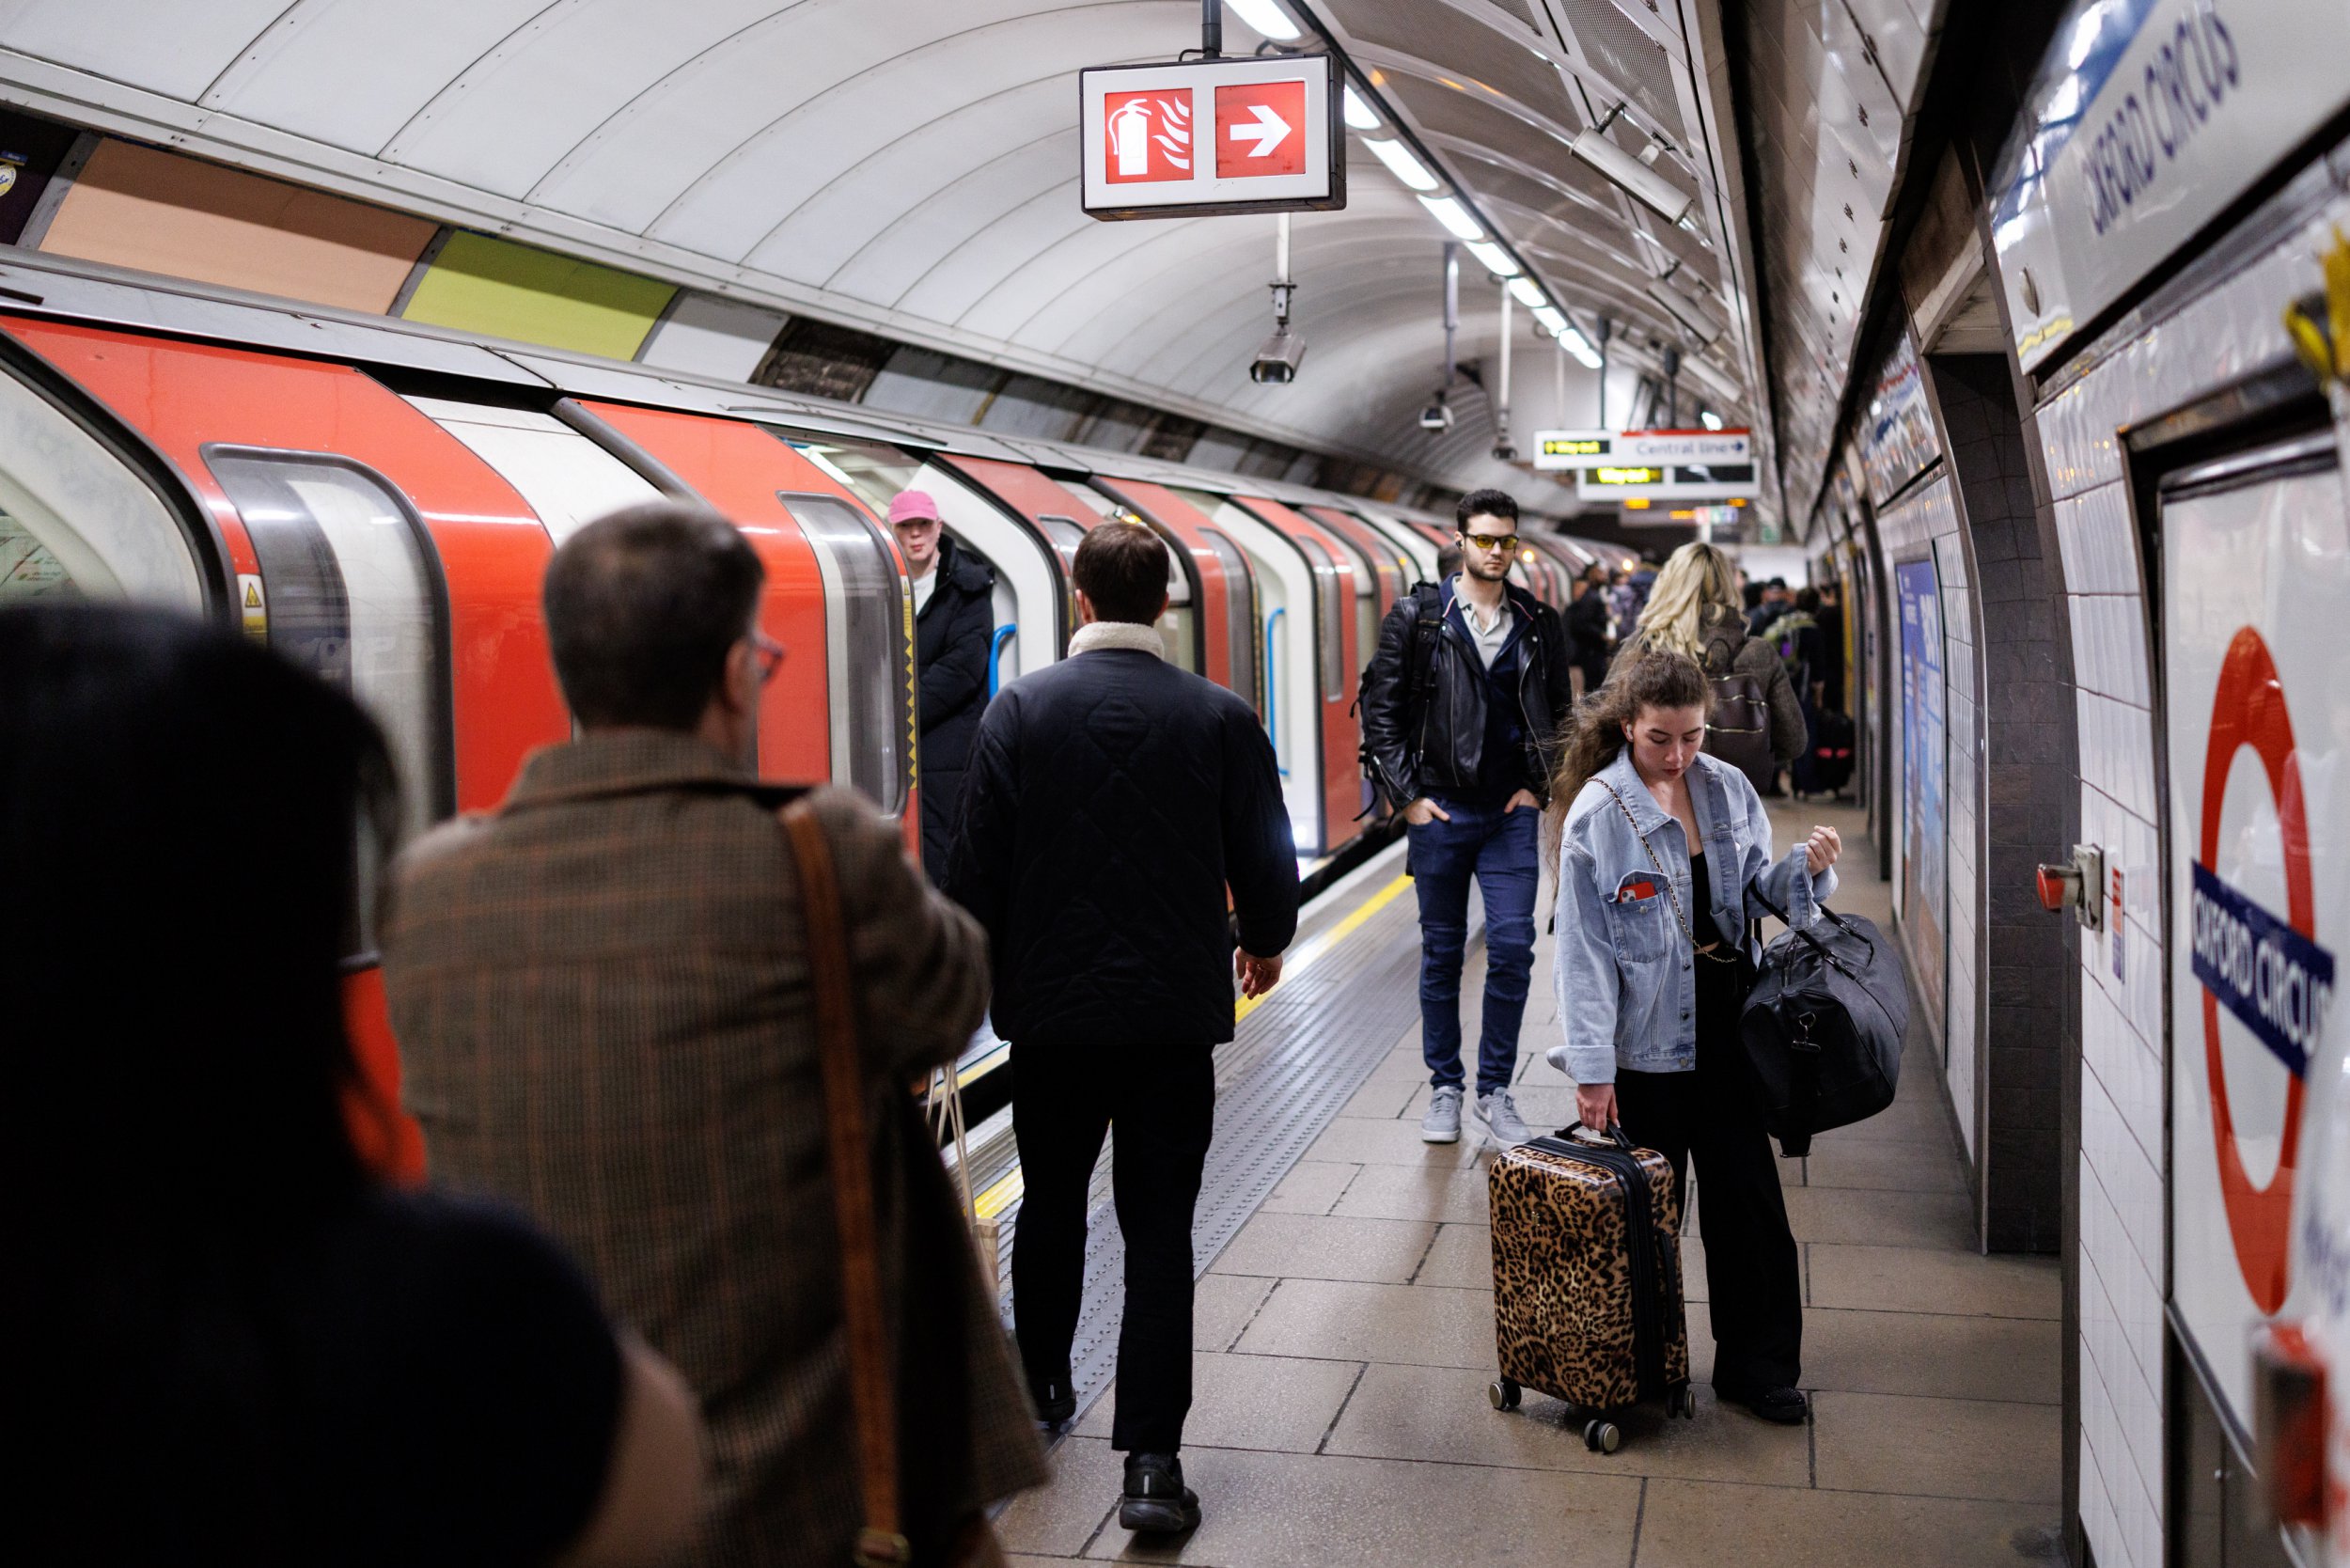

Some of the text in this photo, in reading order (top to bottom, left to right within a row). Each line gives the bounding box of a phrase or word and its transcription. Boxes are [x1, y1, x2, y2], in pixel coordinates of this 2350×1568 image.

[2081, 4, 2240, 236] OXFORD CIRCUS
[1636, 440, 1729, 455] Central line
[2191, 887, 2253, 996] OXFORD
